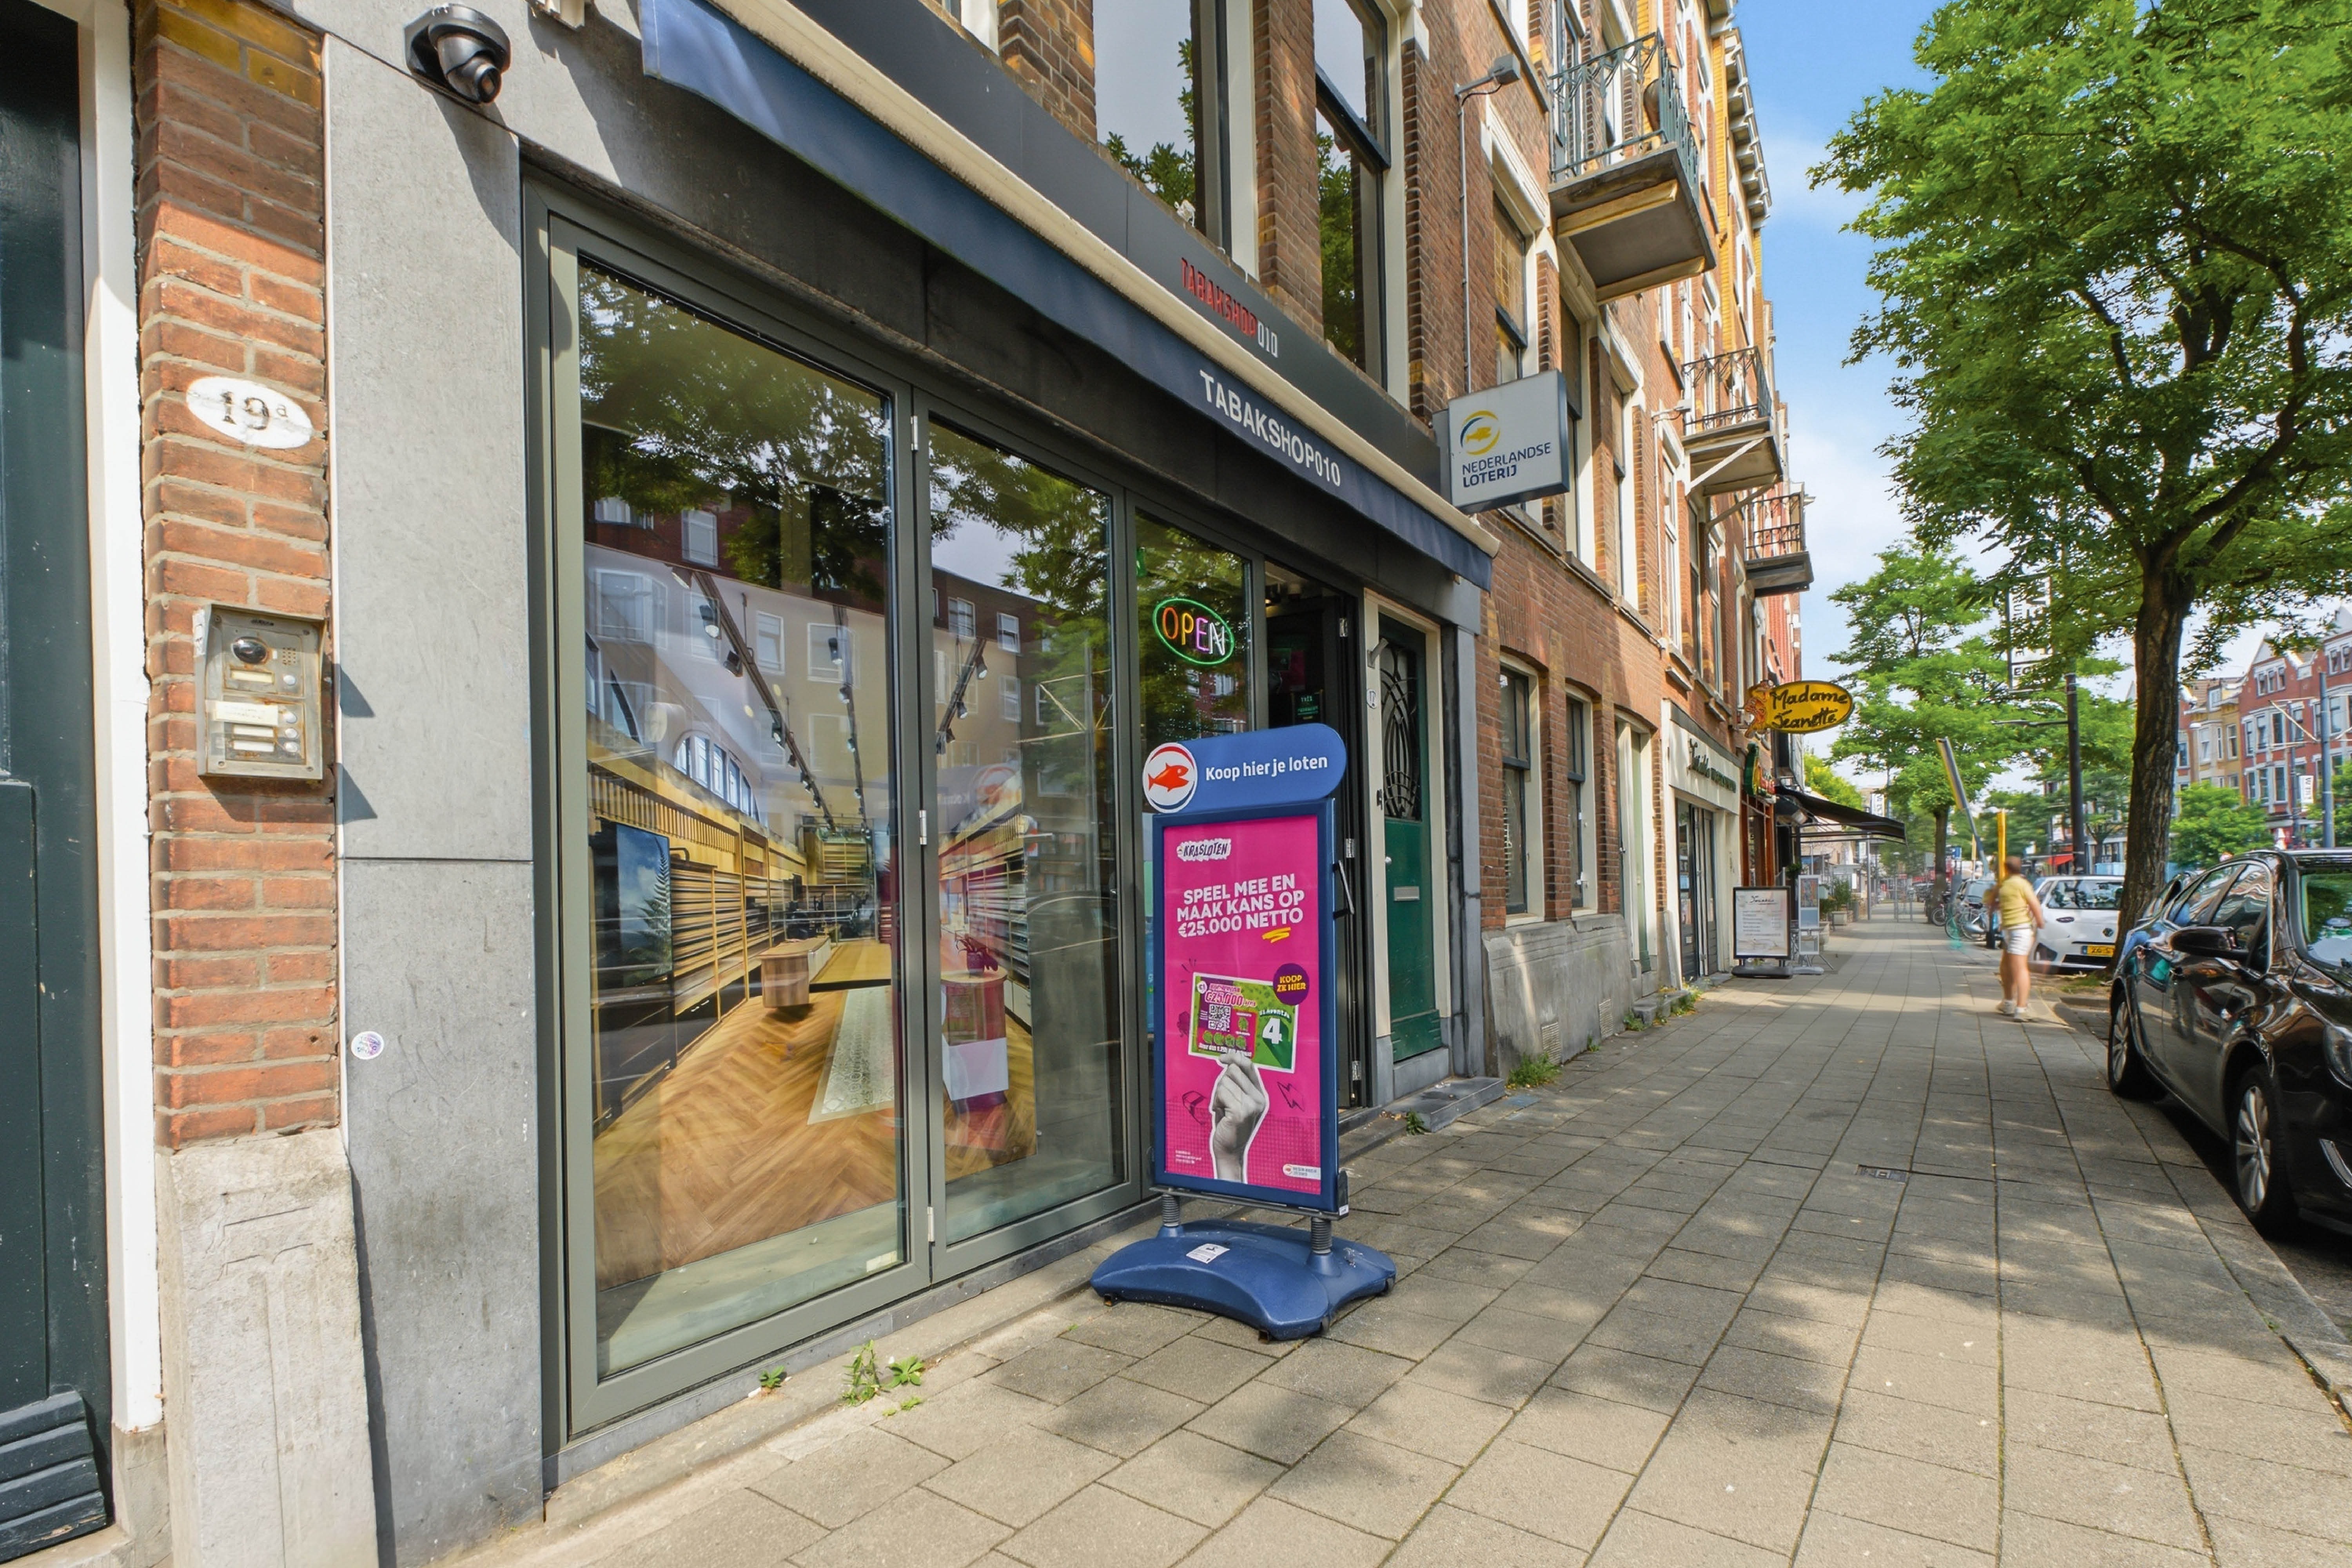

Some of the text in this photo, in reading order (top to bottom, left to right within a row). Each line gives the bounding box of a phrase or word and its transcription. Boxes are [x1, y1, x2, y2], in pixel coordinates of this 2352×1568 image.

[1200, 369, 1341, 487] TABAKSHOP010
[1463, 442, 1551, 475] NEDERLANDSE
[1463, 465, 1517, 488] LOTERIJ
[1162, 607, 1225, 656] OPEN
[1769, 685, 1848, 710] Madame
[1771, 707, 1838, 728] Jeanette
[1206, 756, 1328, 781] Koop hier je loten
[1183, 842, 1228, 857] KRASLOTEN
[1183, 873, 1296, 905] SPEEL MEE EN
[1177, 890, 1305, 922] MAAK KANS OP
[1178, 907, 1304, 938] €25.000 NETTO
[1280, 975, 1302, 983] KOOP
[1288, 982, 1306, 991] HIER
[1262, 1017, 1283, 1044] 4
